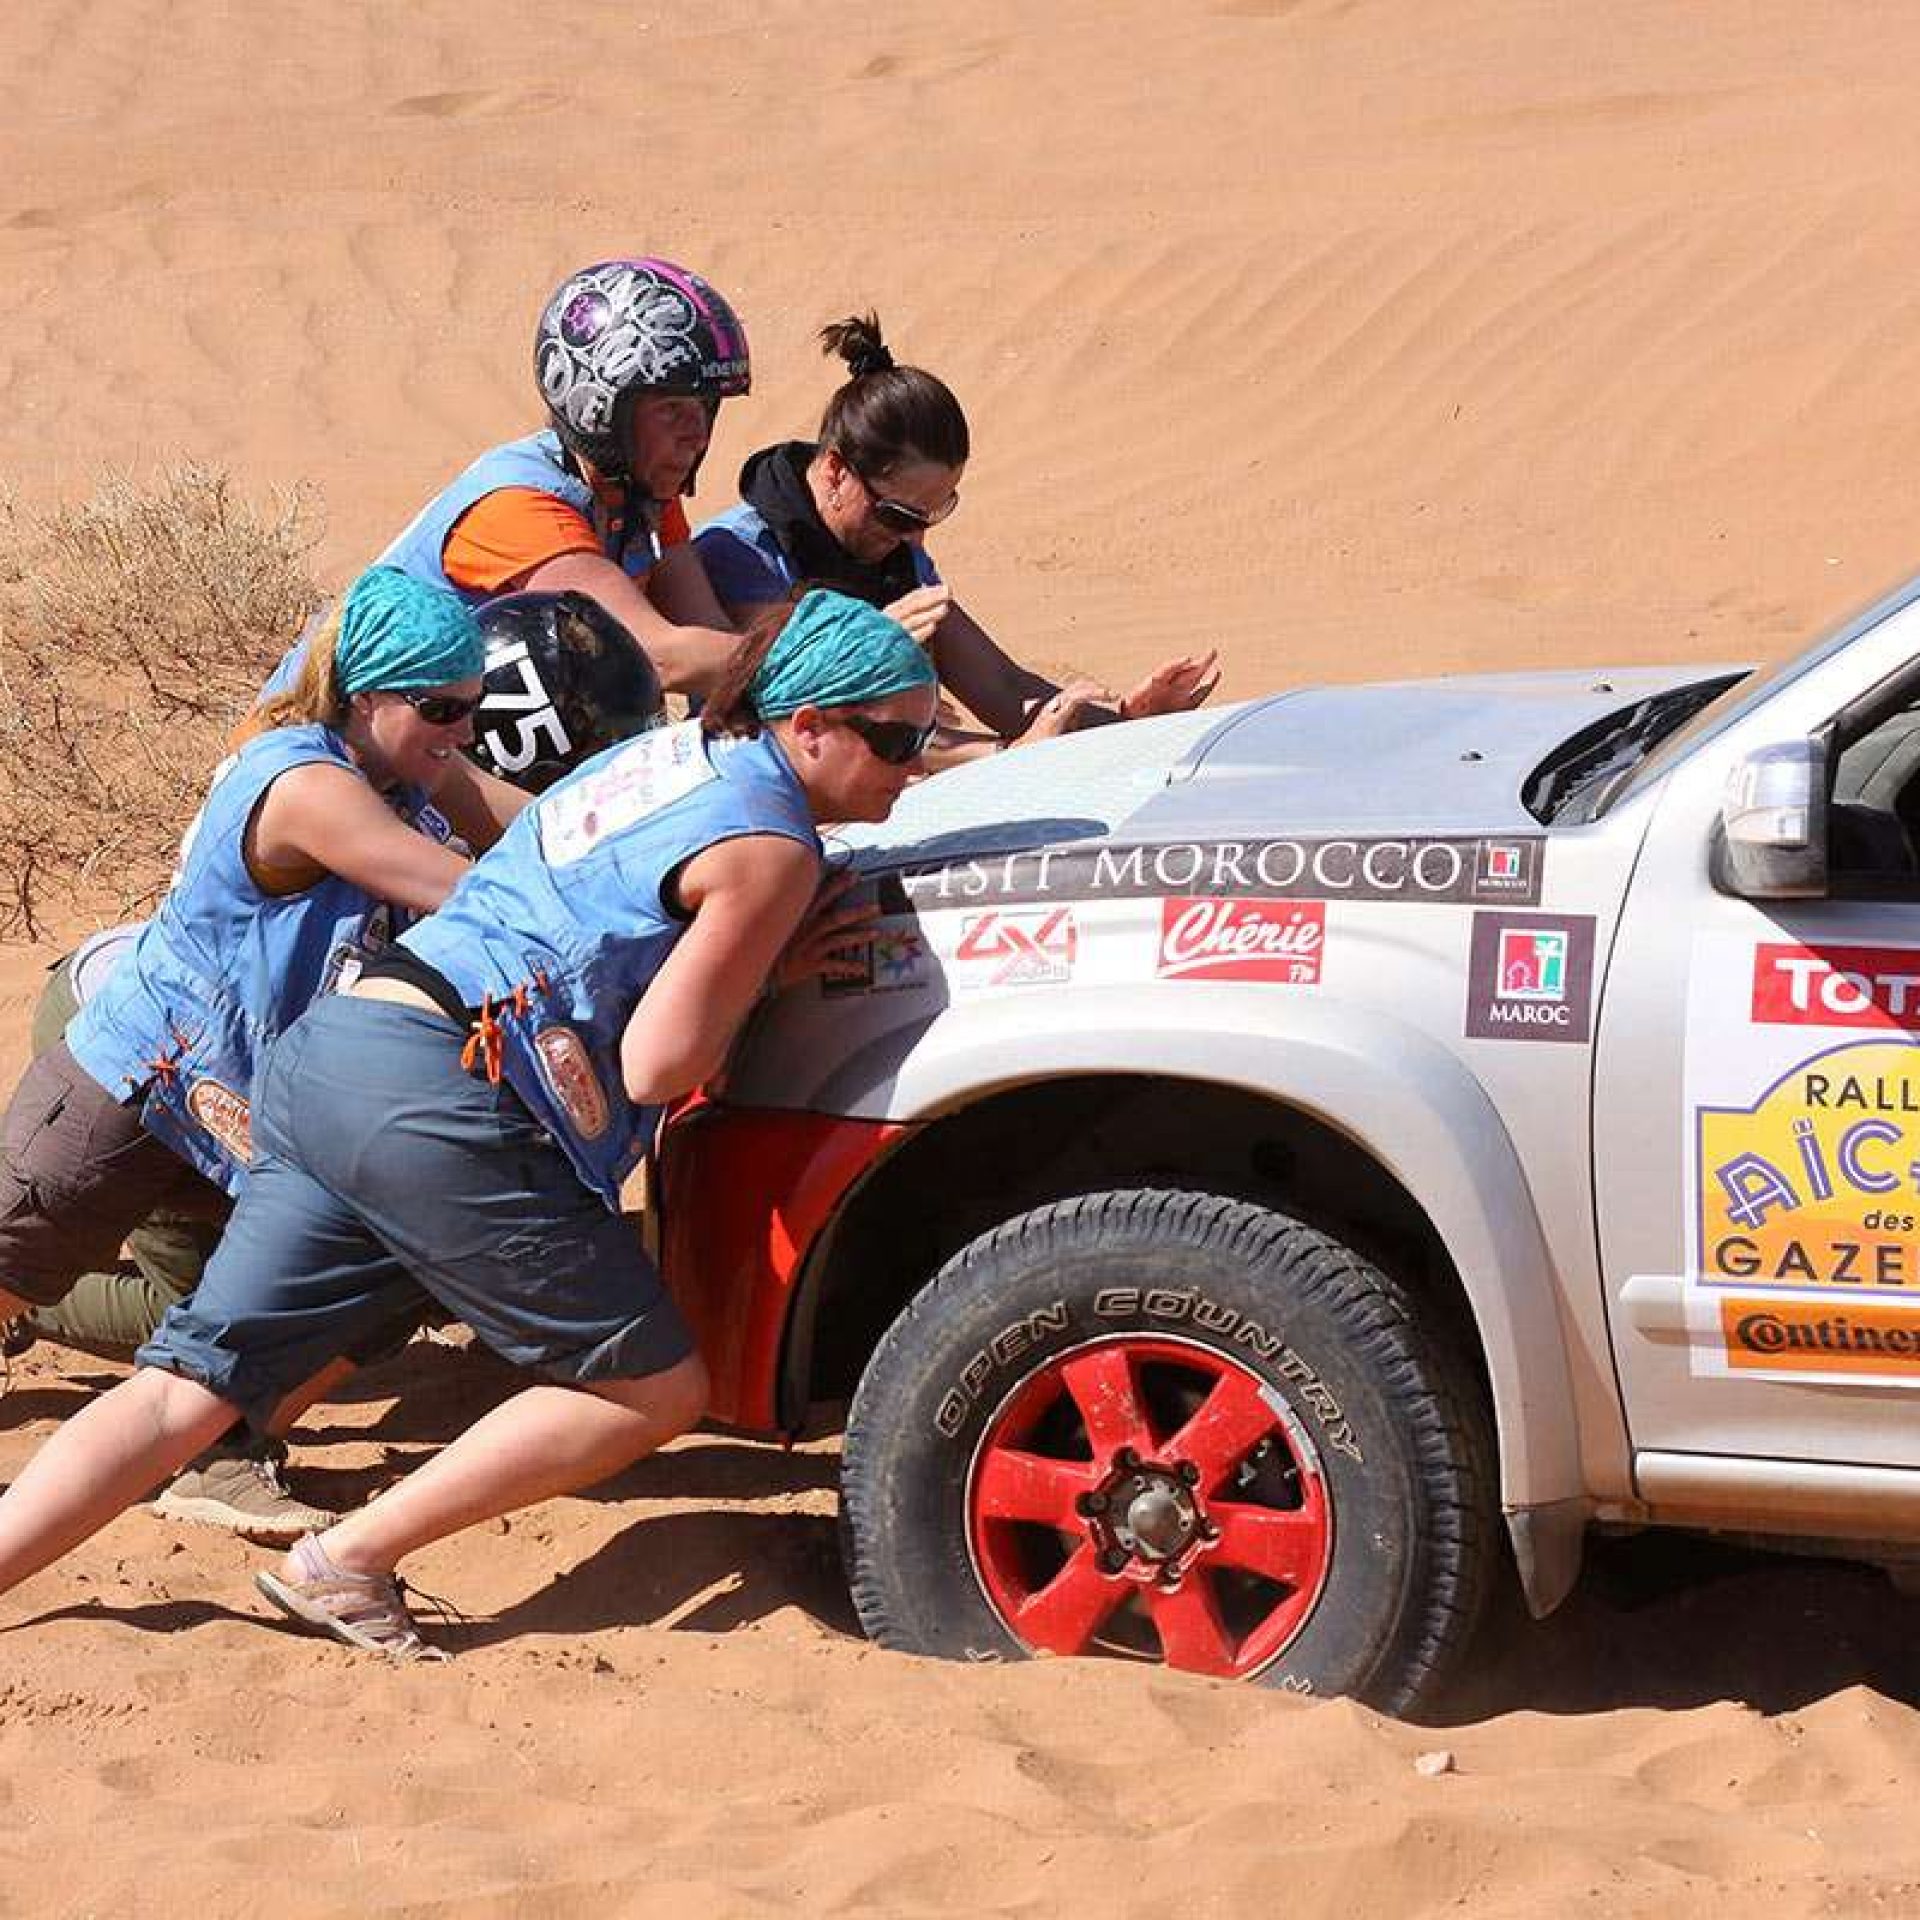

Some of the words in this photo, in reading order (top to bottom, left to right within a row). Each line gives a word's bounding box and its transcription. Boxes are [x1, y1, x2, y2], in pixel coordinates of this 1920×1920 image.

[1092, 839, 1462, 892] MOROCCO
[1163, 901, 1322, 961] Chérie
[1489, 1003, 1570, 1026] MAROC
[1775, 957, 1920, 1015] TOT
[1715, 1116, 1920, 1230] AÏC
[1863, 1209, 1914, 1231] des
[933, 1301, 1070, 1438] OPEN
[1092, 1286, 1365, 1465] COUNTRY
